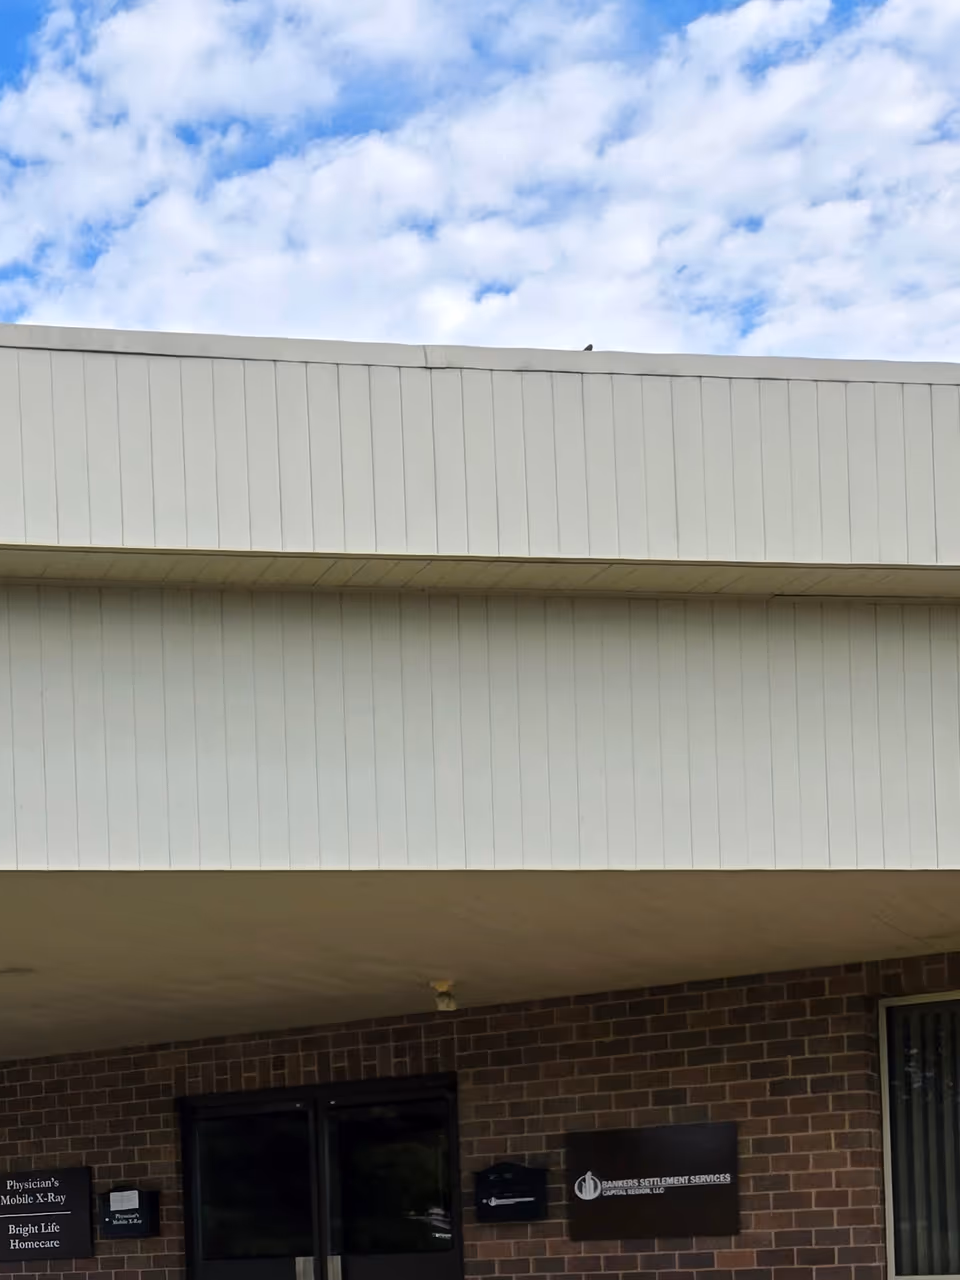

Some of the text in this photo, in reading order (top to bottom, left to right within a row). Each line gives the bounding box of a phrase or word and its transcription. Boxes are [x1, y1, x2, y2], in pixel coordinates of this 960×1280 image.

[6, 1177, 59, 1192] Physician's
[601, 1173, 731, 1189] BANKERS SETTLEMENT SERVICES
[0, 1192, 66, 1206] Mobile X-Ray
[601, 1188, 627, 1197] CAPITAL
[8, 1222, 60, 1237] Bright Life
[9, 1238, 60, 1250] Homecare
